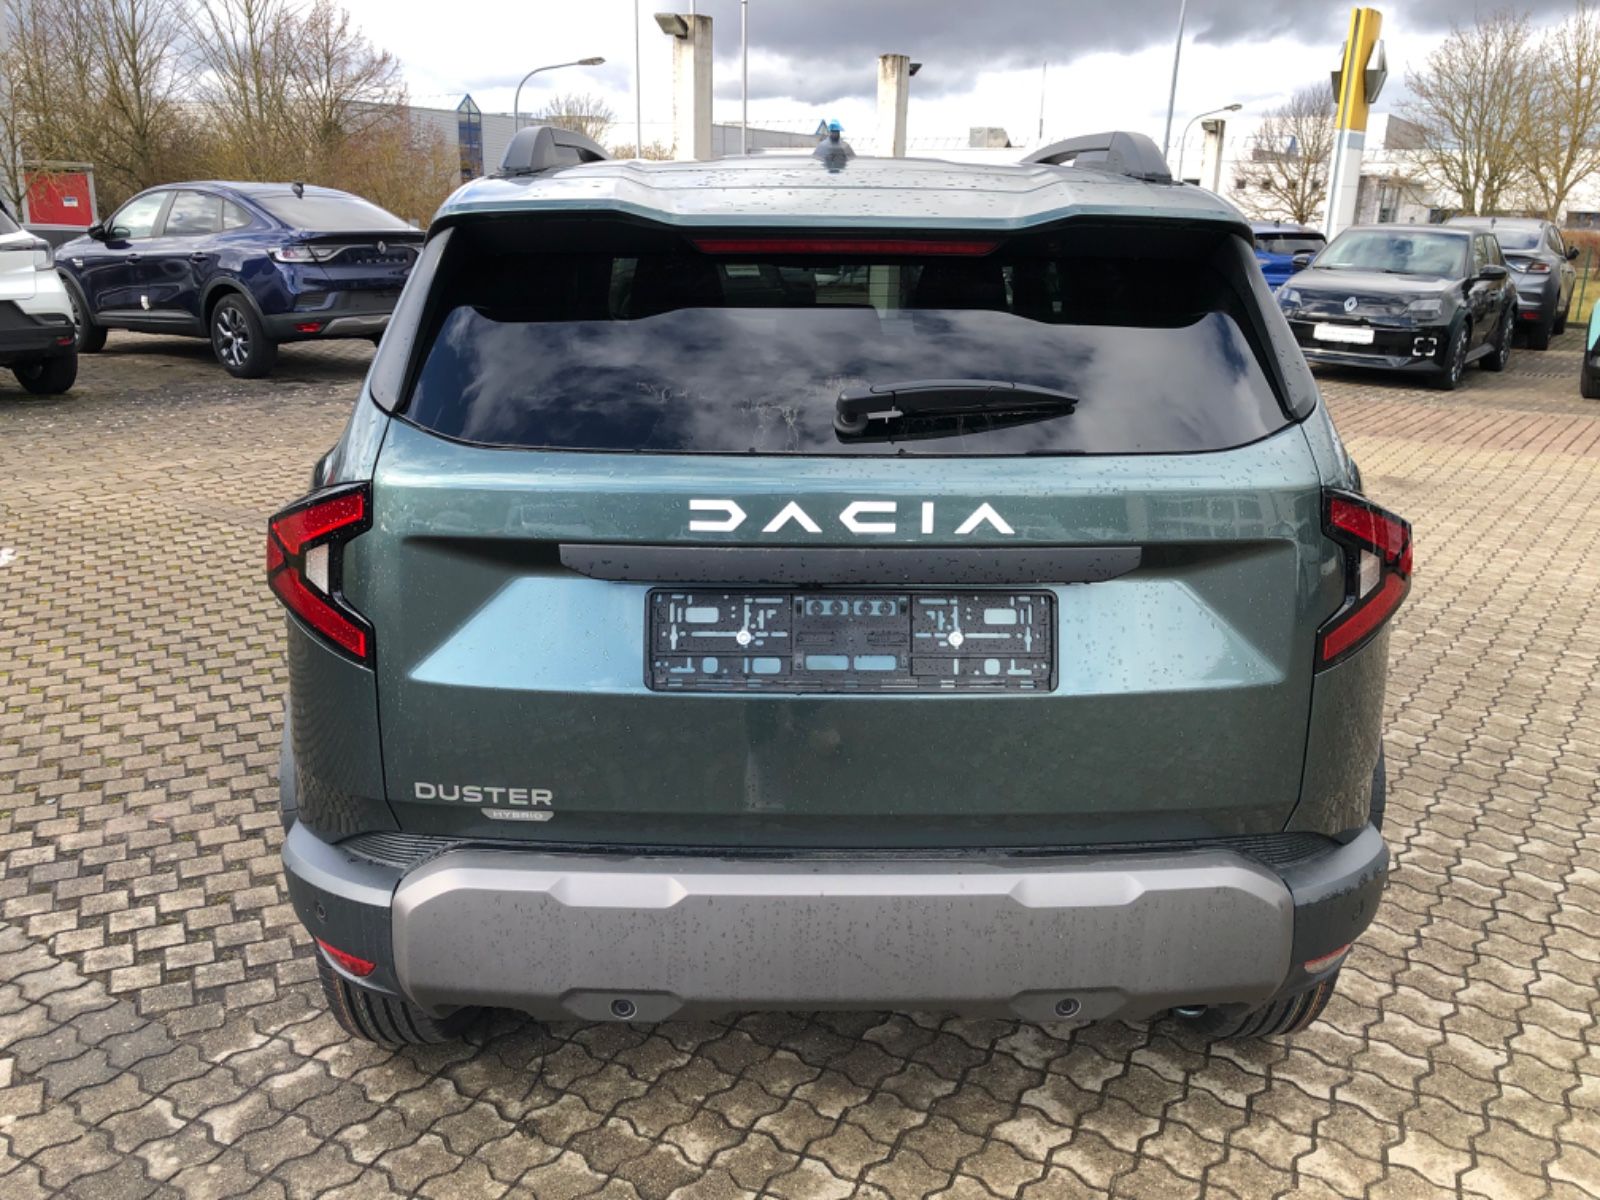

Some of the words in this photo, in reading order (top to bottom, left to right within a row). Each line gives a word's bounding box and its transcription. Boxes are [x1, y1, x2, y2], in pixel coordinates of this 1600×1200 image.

[689, 499, 1015, 534] DACIA
[414, 782, 553, 806] DUSTER
[492, 810, 544, 820] HYBRID
